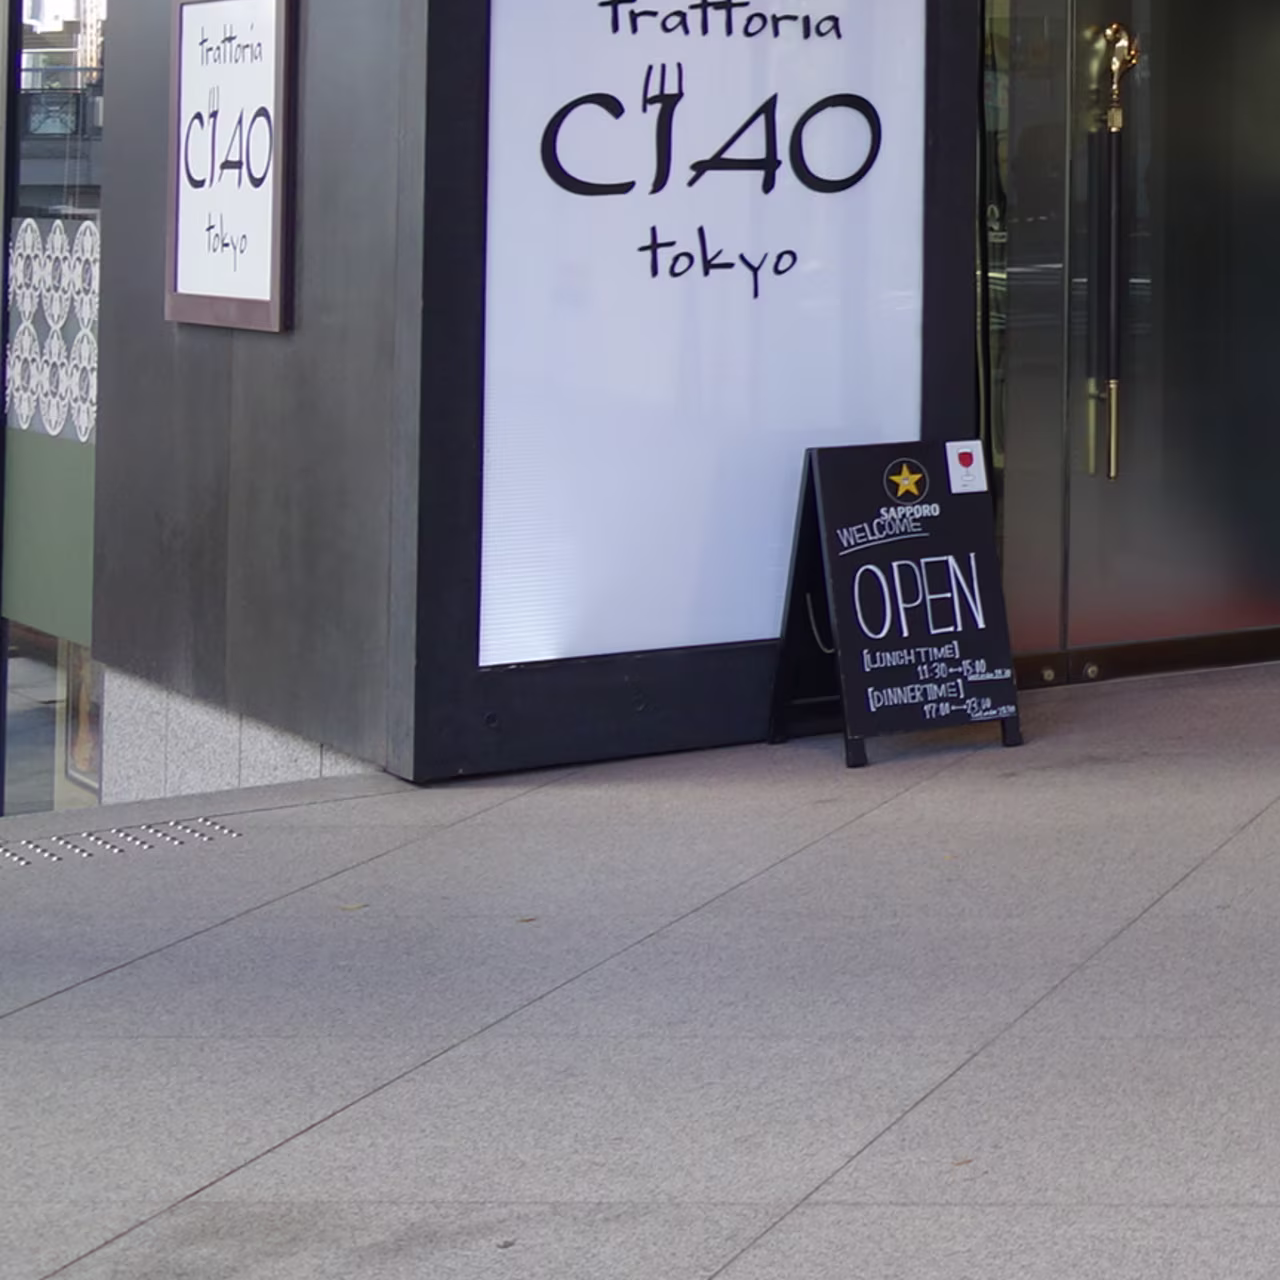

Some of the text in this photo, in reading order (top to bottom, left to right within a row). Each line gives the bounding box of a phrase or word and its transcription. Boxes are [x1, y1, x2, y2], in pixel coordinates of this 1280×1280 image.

[198, 23, 263, 67] trattoria
[183, 87, 273, 189] CIAO
[540, 62, 882, 197] CIAO
[205, 214, 248, 272] tokyo
[637, 225, 797, 299] tokyo
[836, 518, 923, 548] WELCOME
[879, 503, 940, 520] SAPPORO
[853, 552, 986, 639] OPEN
